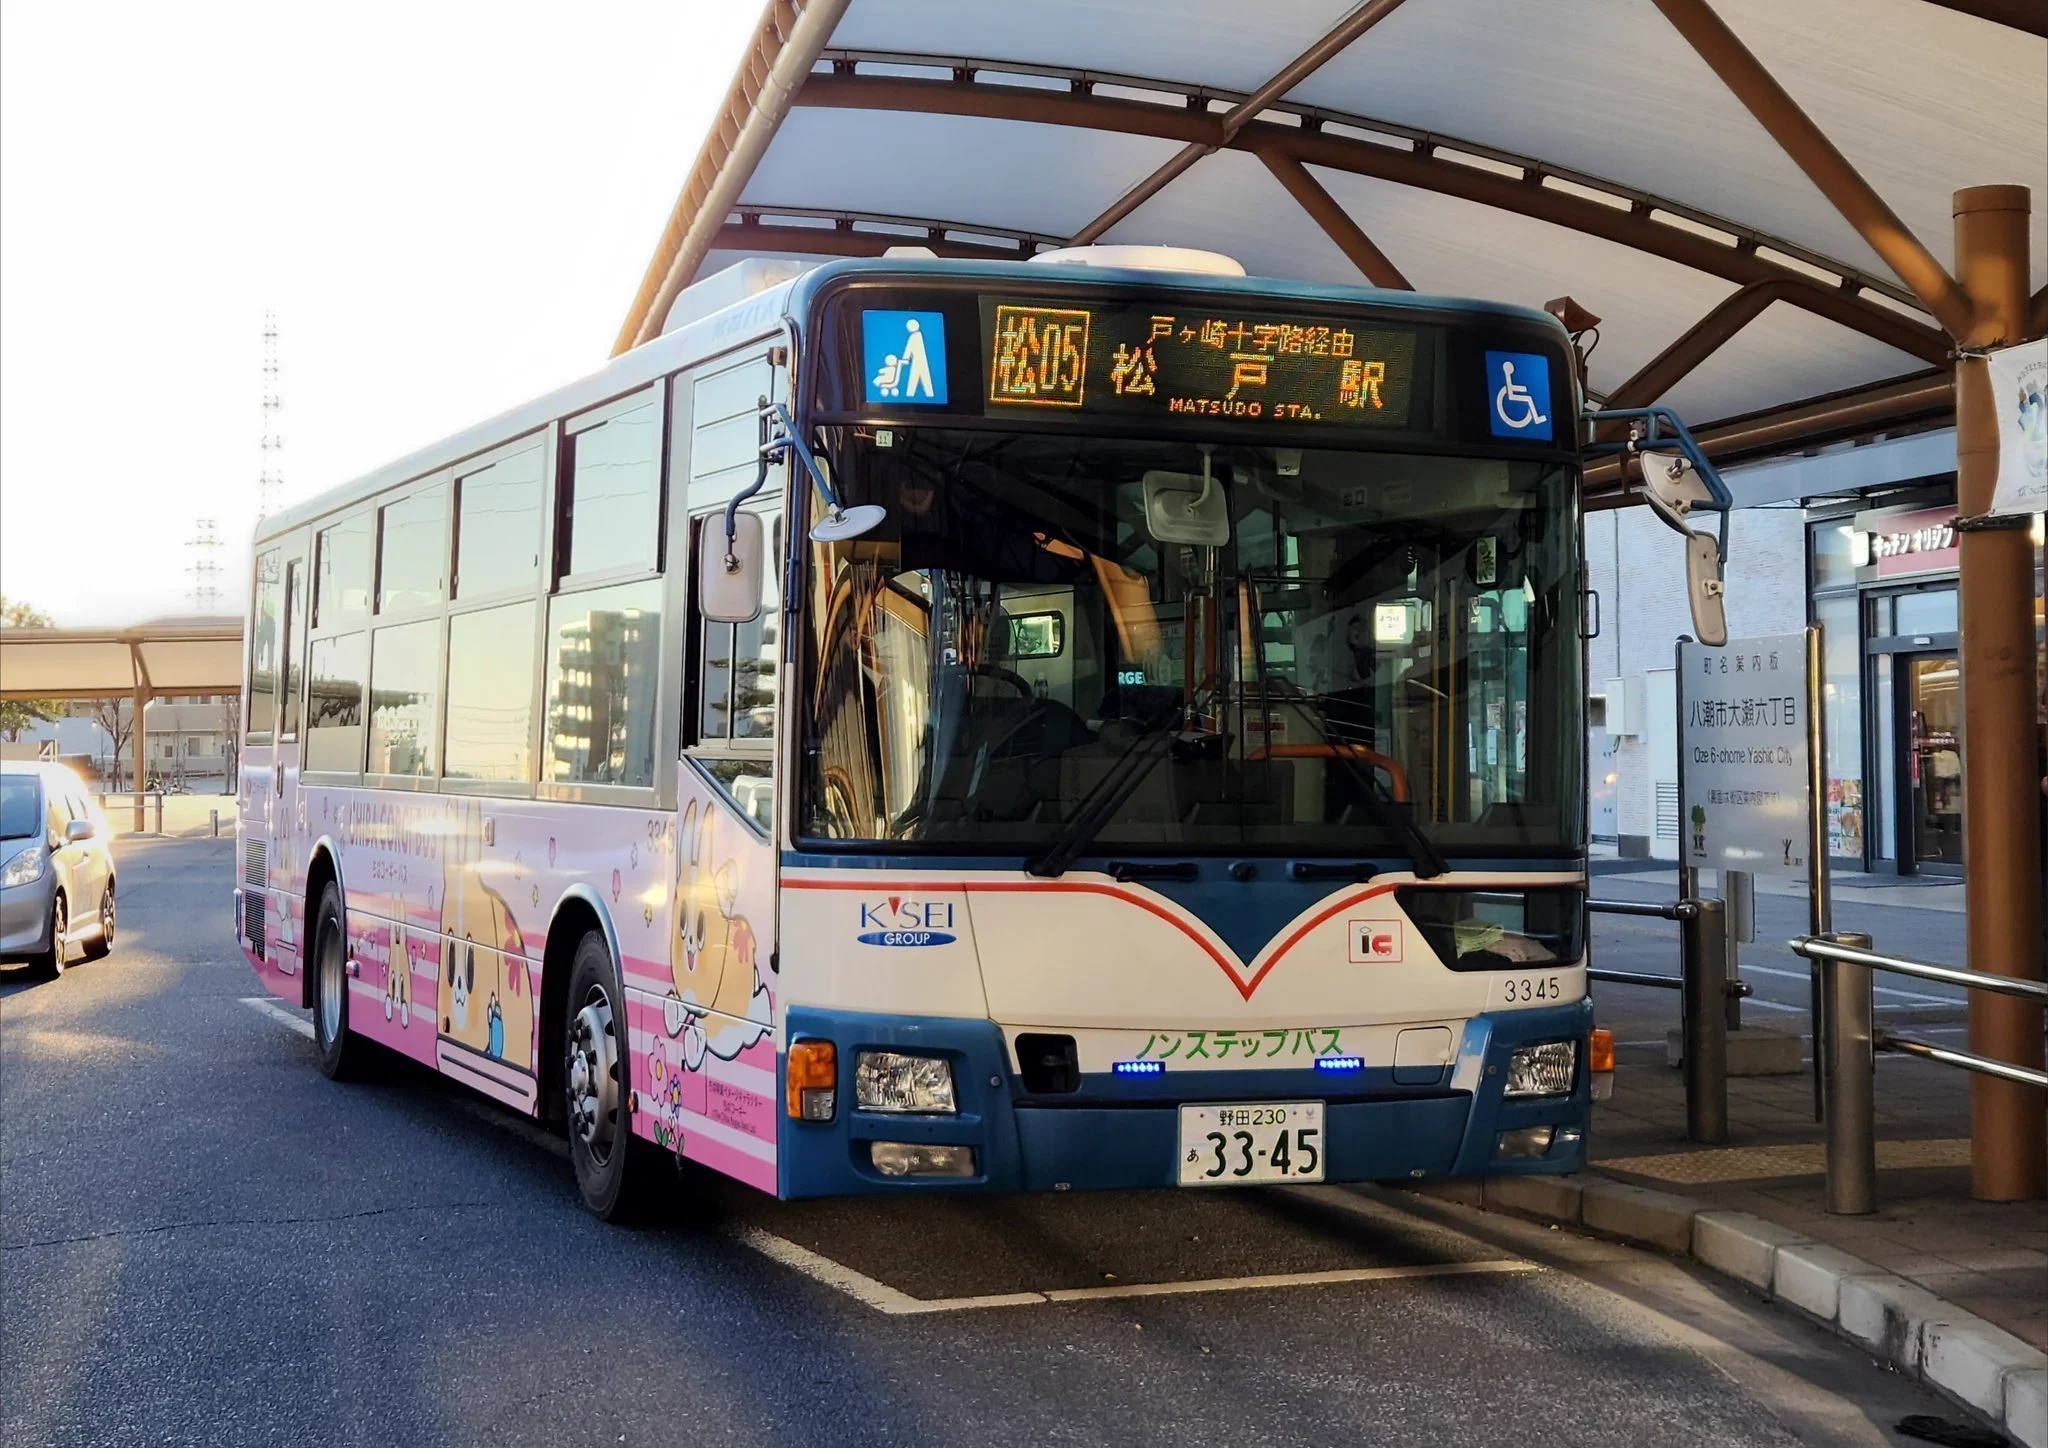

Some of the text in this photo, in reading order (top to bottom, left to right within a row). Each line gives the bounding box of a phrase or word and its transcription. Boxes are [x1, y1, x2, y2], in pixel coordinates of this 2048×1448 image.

[1000, 316, 1082, 394] 松05
[1169, 397, 1321, 420] MATSUDO STA.
[1690, 697, 1795, 728] 八潮市大瀬六丁目
[1694, 746, 1709, 763] Oze
[1710, 746, 1746, 764] 6-chome
[884, 932, 931, 945] GROUP
[1504, 977, 1560, 1003] 3345
[1136, 1028, 1344, 1060] ノンステップバス
[1186, 1128, 1319, 1178] あ 33-45
